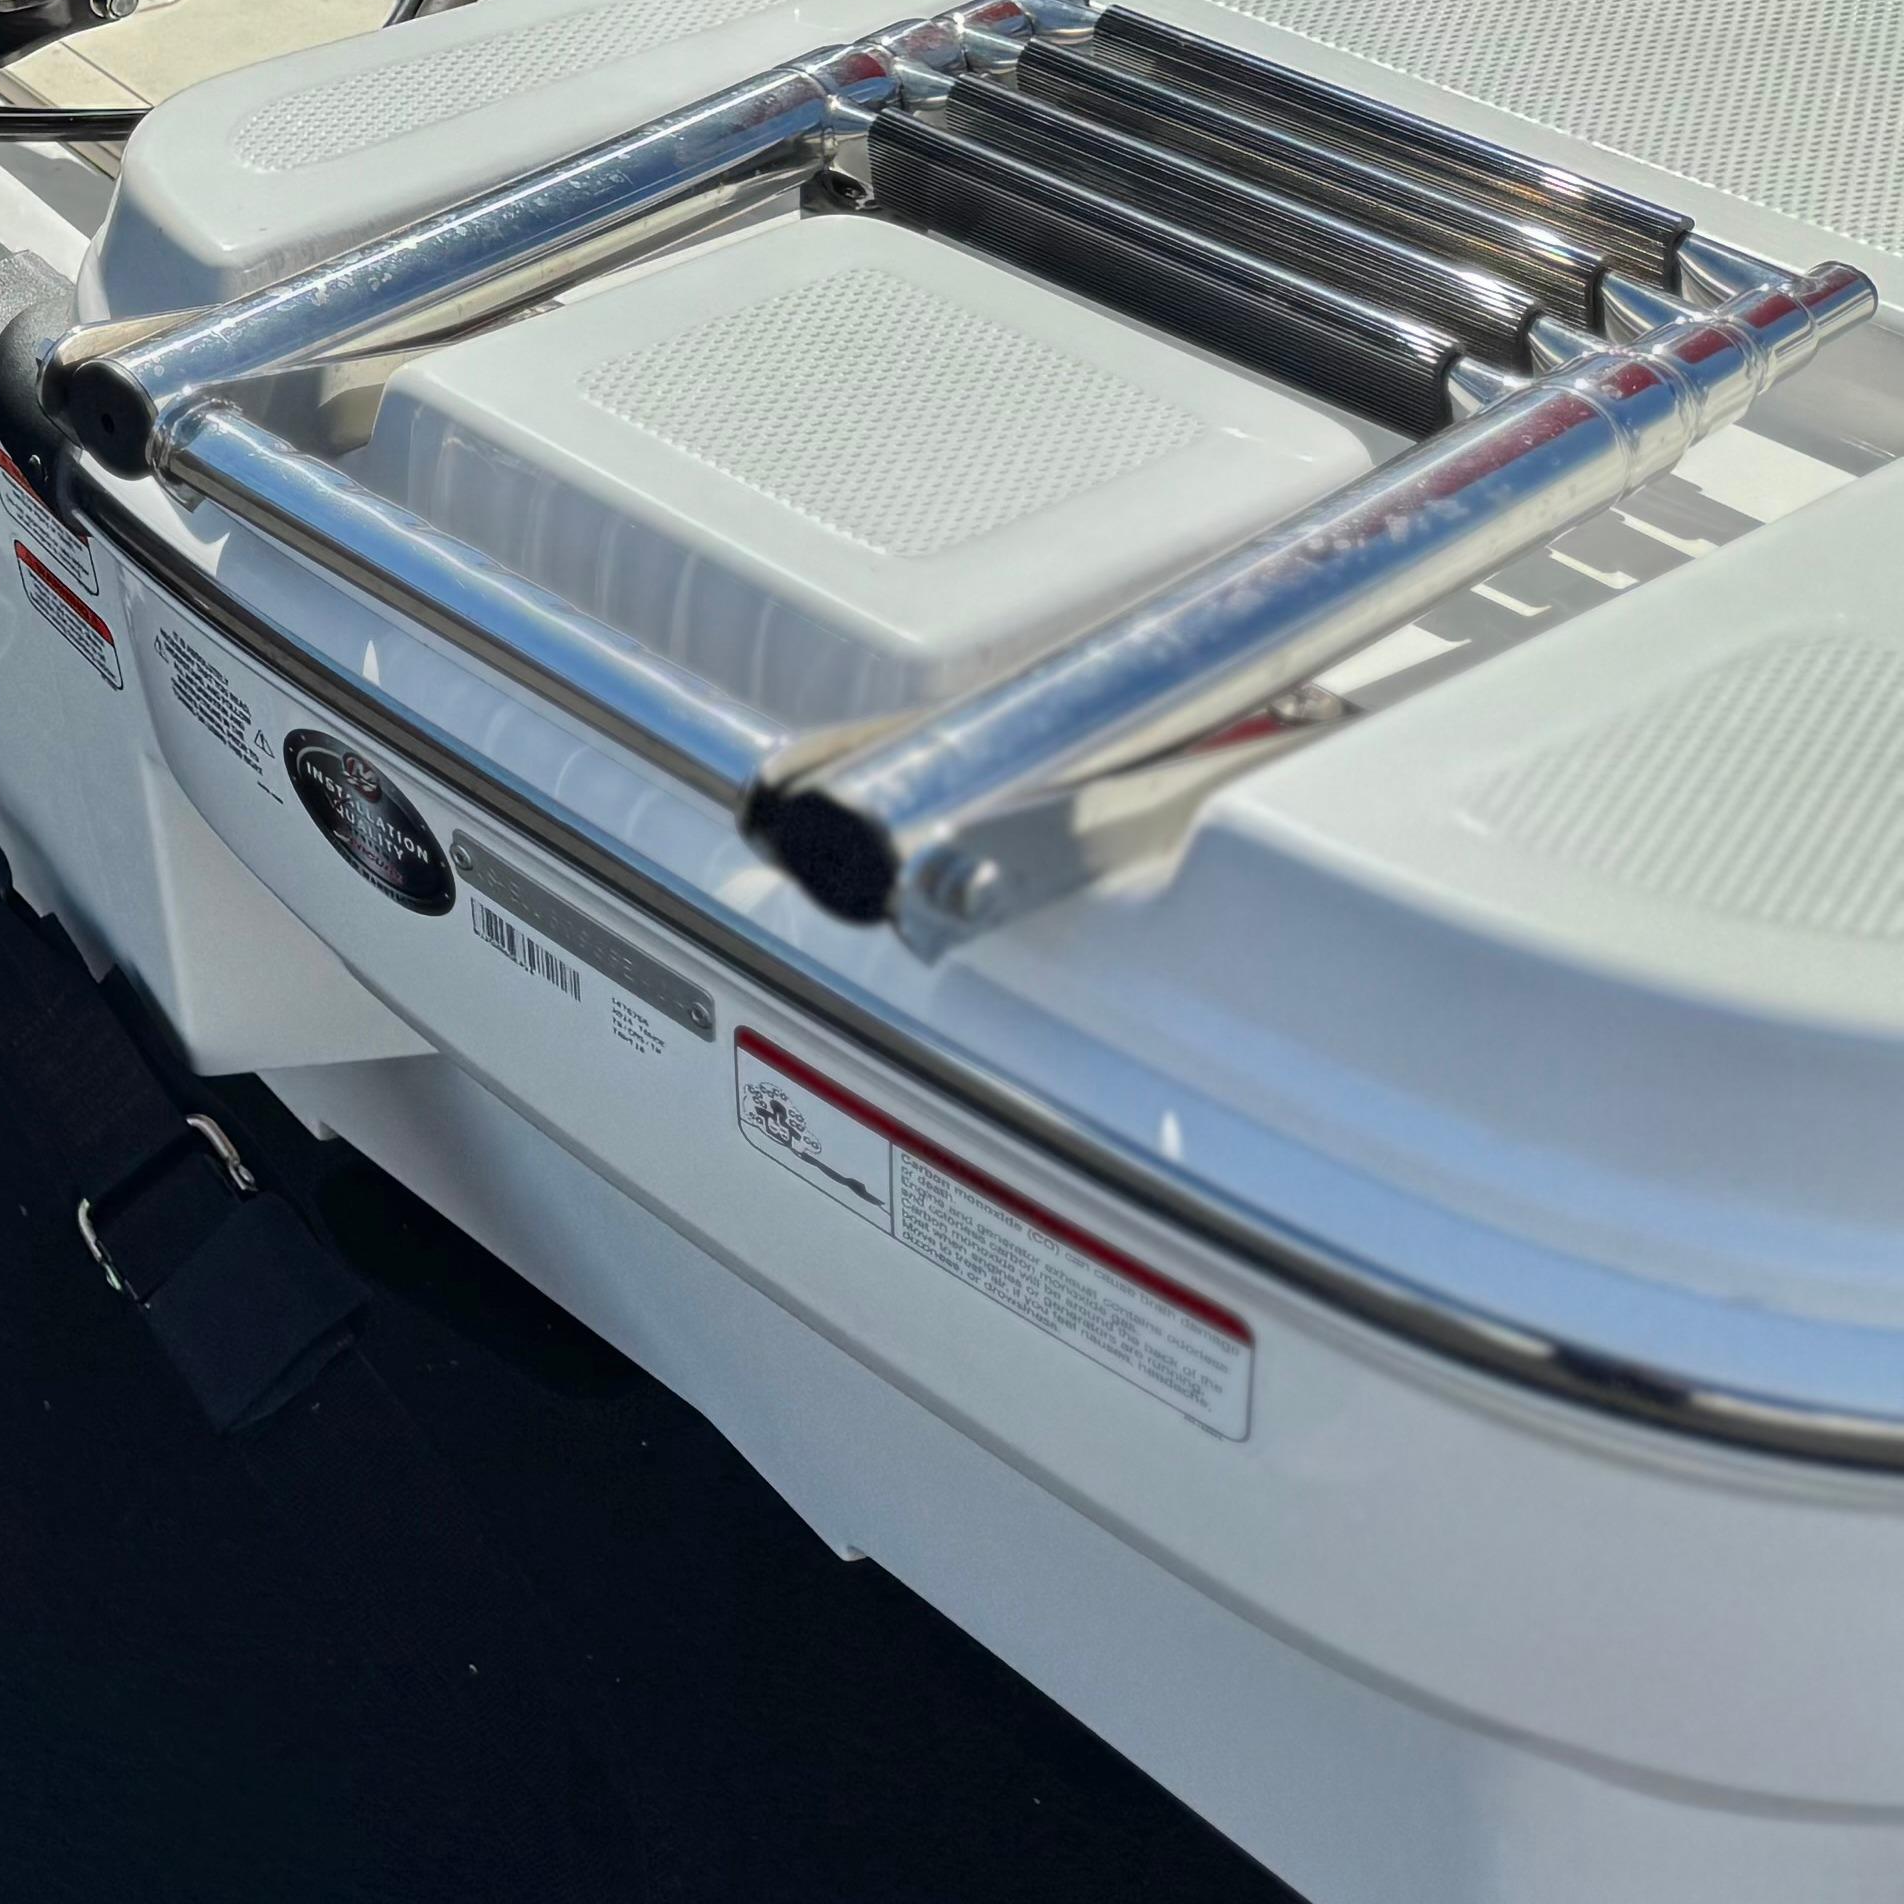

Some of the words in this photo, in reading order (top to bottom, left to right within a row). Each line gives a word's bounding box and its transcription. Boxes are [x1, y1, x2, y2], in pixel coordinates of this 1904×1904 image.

[306, 761, 429, 864] INSTALLATION
[334, 797, 404, 860] QUALITY
[901, 1152, 950, 1189] Carbon
[954, 1185, 1022, 1233] monoxide
[1026, 1226, 1058, 1256] (CO)
[901, 1195, 947, 1232] Carbon
[901, 1174, 944, 1208] Engine
[949, 1206, 972, 1226] and
[977, 1222, 1038, 1265] generator
[989, 1240, 1032, 1272] carbon
